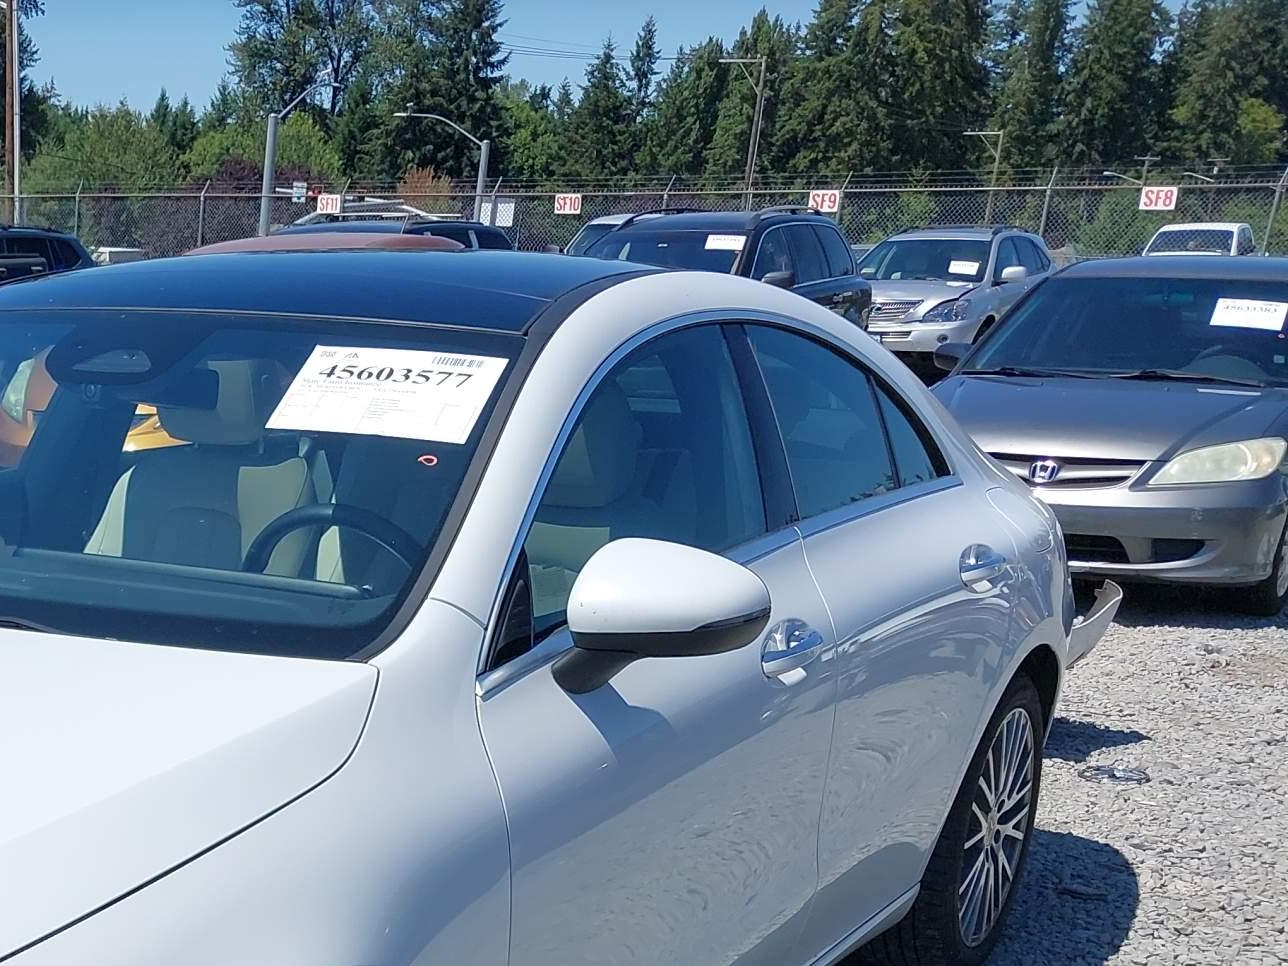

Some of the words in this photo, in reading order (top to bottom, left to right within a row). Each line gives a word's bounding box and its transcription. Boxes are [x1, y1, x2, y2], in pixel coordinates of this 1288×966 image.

[319, 196, 339, 212] SF11
[556, 195, 581, 212] SF10
[811, 193, 837, 210] SF9
[1143, 189, 1174, 208] SF8
[318, 363, 475, 389] 45603577
